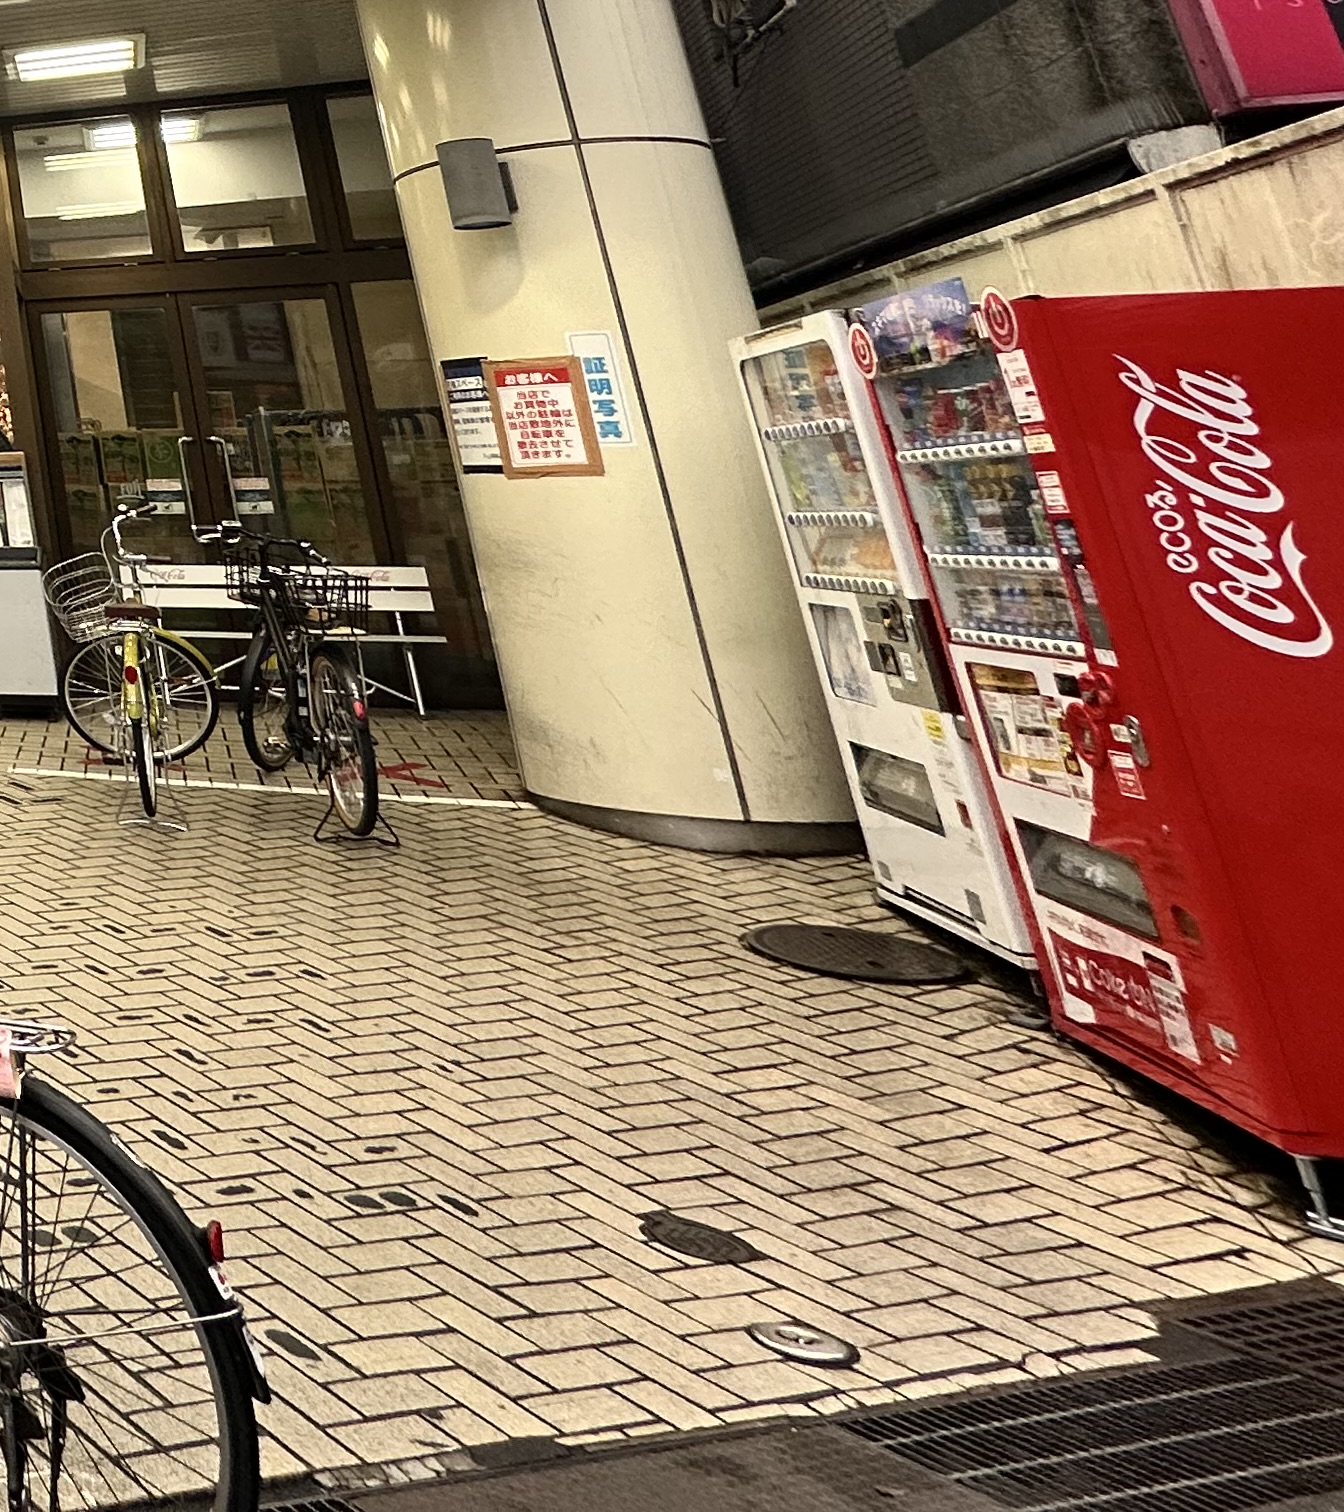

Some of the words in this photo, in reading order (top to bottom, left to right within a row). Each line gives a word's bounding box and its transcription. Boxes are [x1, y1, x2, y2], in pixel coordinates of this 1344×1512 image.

[504, 372, 559, 384] お客様へ
[517, 390, 550, 399] 当店で
[582, 357, 623, 438] 証明写真
[514, 399, 558, 409] お買物中
[520, 430, 565, 439] 自転車を
[1112, 353, 1334, 658] Coca-Cola
